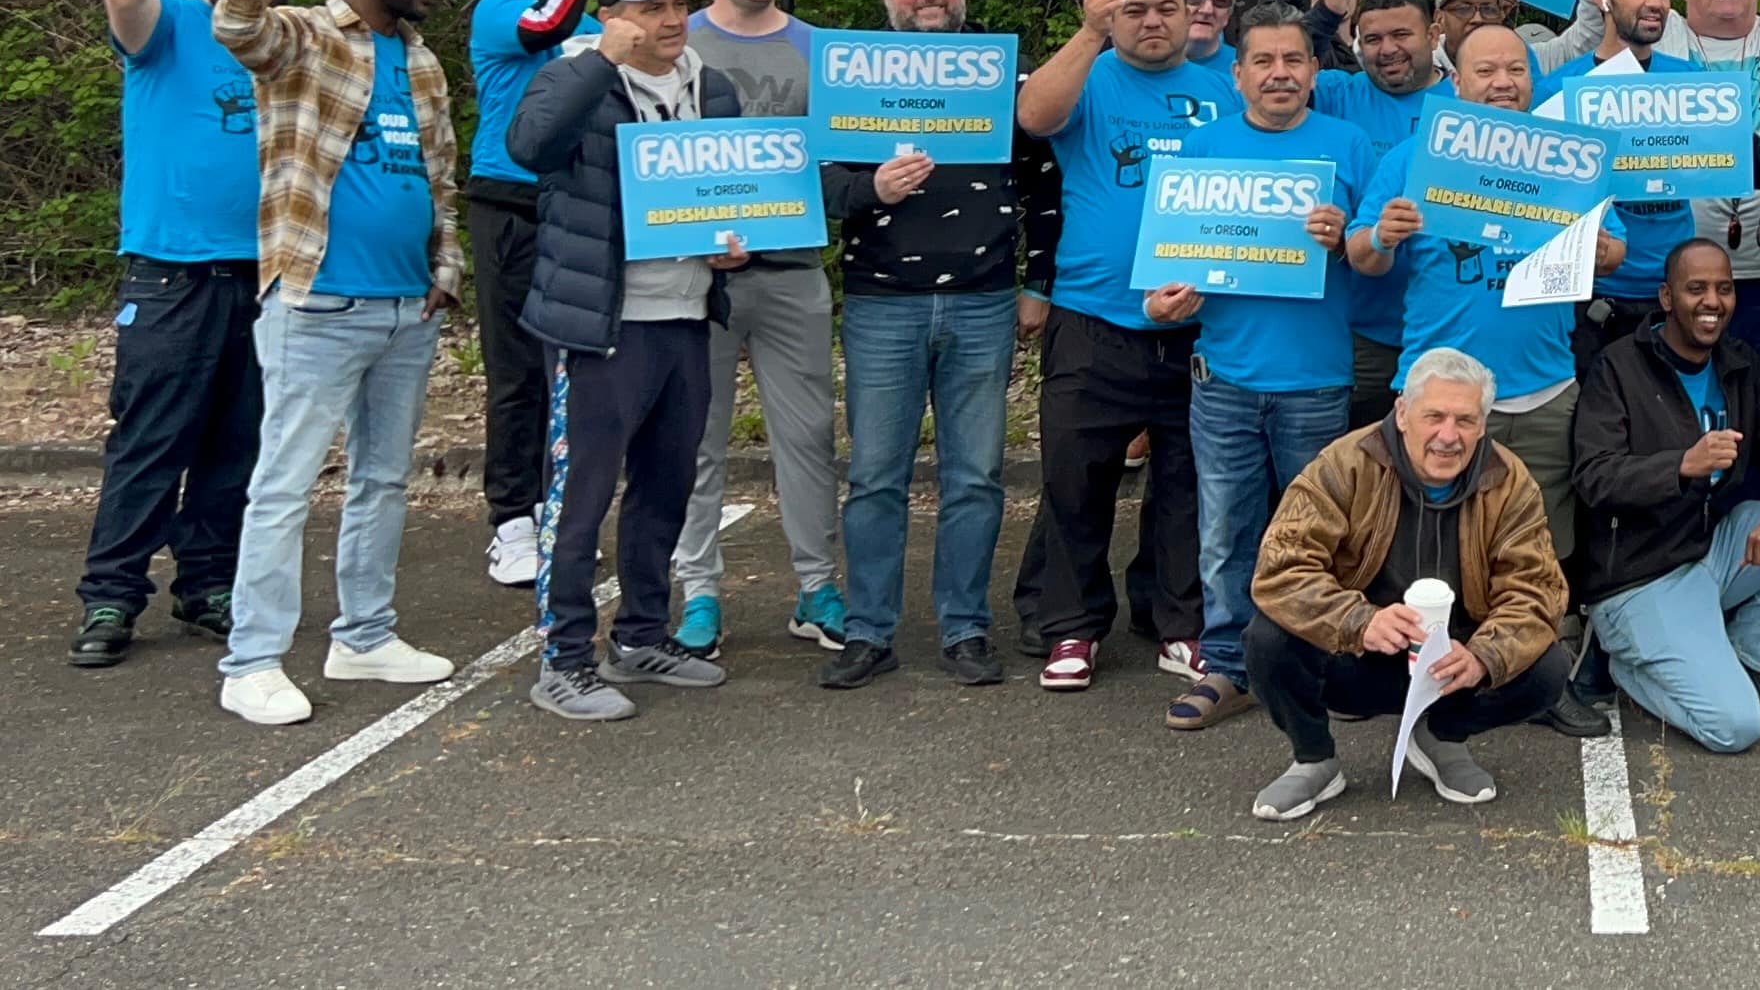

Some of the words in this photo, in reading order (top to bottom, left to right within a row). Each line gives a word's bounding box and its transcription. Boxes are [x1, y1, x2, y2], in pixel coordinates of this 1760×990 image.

[828, 47, 1001, 86] FAIRNESS
[881, 98, 895, 108] for
[898, 98, 945, 109] OREGON
[1580, 87, 1738, 124] FAIRNESS
[377, 113, 408, 127] OUR
[829, 115, 921, 132] RIDESHARE
[924, 118, 993, 133] DRIVERS
[1147, 138, 1182, 152] OUR
[1434, 116, 1602, 179] FAIRNESS
[1631, 136, 1645, 146] for
[1647, 135, 1689, 146] OREGON
[638, 134, 802, 175] FAIRNESS
[1670, 153, 1735, 169] DRIVERS
[697, 186, 712, 197] for
[714, 184, 758, 196] OREGON
[1159, 175, 1316, 215] FAIRNESS
[1479, 174, 1494, 187] for
[1495, 177, 1540, 195] OREGON
[1425, 186, 1513, 216] RIDESHARE
[647, 204, 739, 225] RIDESHARE
[741, 201, 806, 219] DRIVERS
[1200, 224, 1214, 235] for
[1215, 224, 1258, 236] OREGON
[1154, 242, 1234, 260] RIDESHARE
[1236, 245, 1306, 265] DRIVERS
